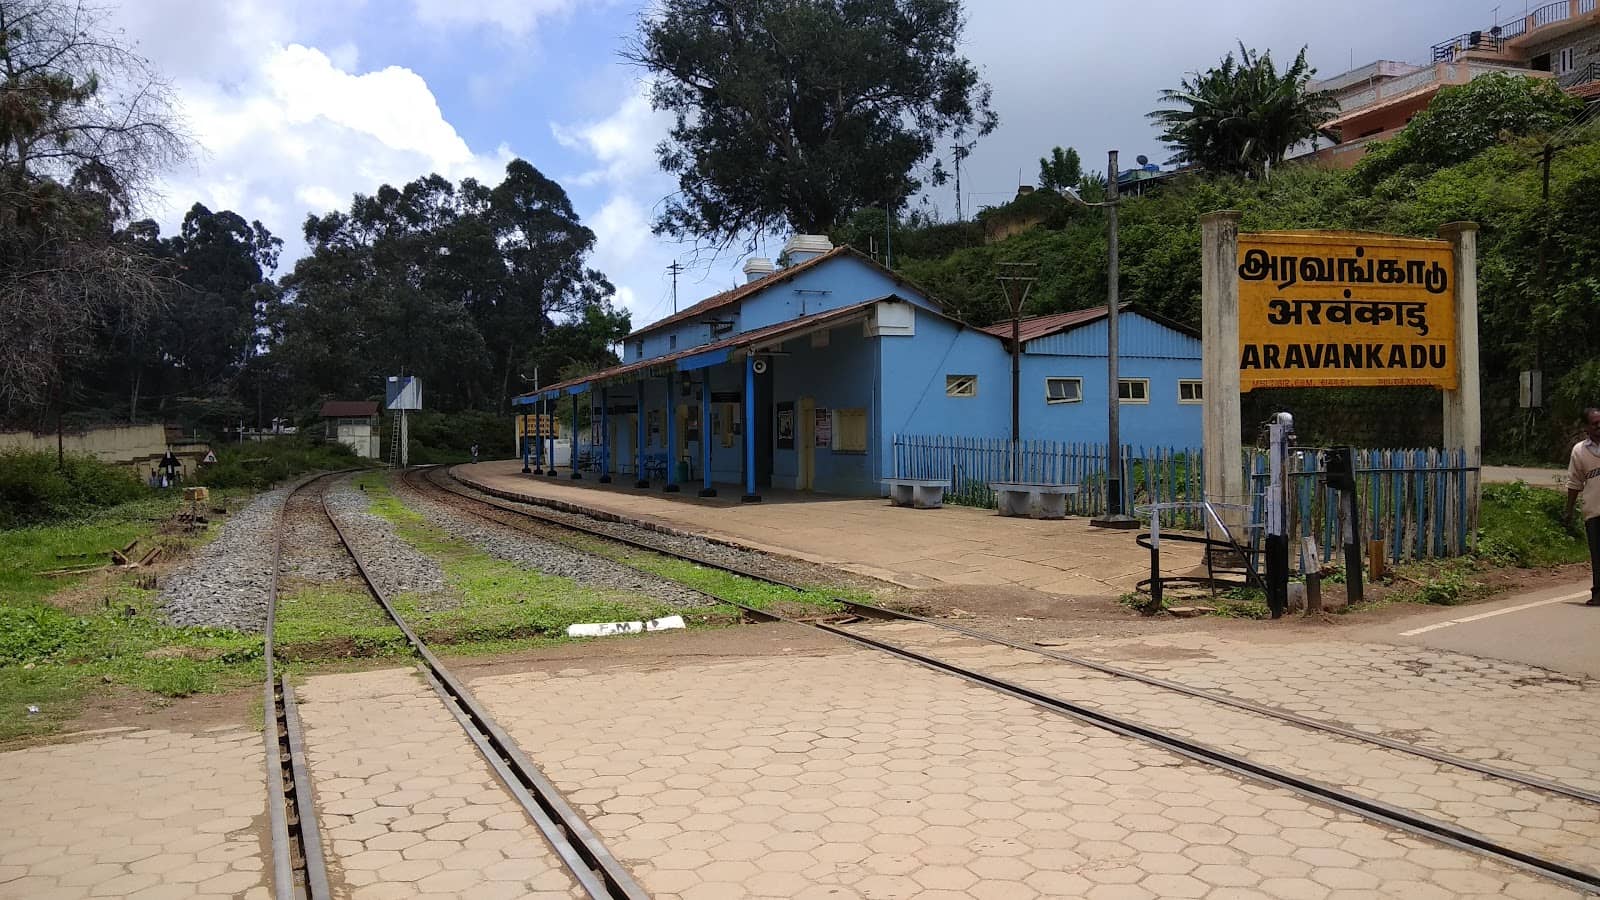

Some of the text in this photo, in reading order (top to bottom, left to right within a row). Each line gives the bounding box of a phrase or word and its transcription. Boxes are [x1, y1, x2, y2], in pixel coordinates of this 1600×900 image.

[1239, 247, 1447, 293] அரவங்காடு
[1268, 290, 1428, 336] अरवंकाडु
[1240, 344, 1446, 369] ARAVANKADU
